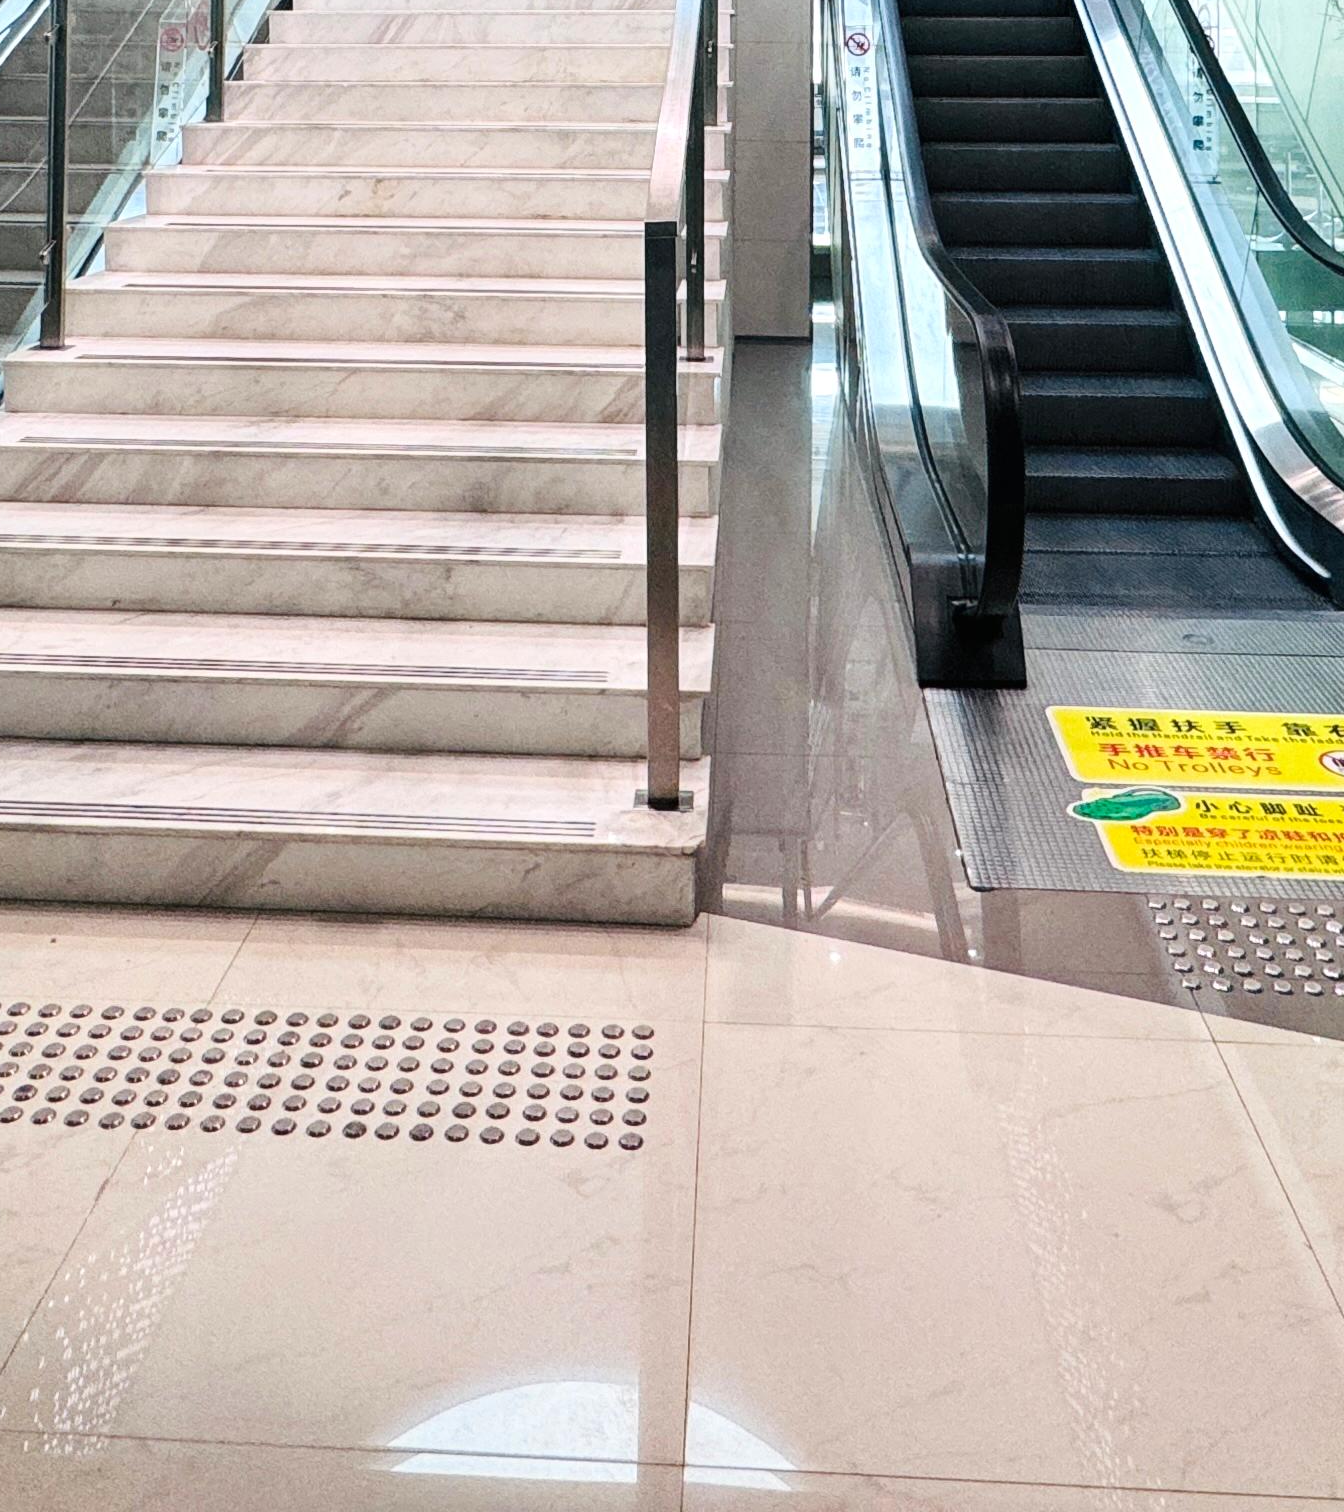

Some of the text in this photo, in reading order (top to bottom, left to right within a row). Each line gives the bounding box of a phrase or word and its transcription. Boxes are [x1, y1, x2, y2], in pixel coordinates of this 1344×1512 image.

[1085, 716, 1246, 734] 紧握扶手
[1246, 735, 1279, 743] Take
[1283, 736, 1309, 744] the
[1099, 743, 1275, 761] 手推车禁行
[1108, 758, 1282, 777] No Trolleys
[1196, 800, 1321, 817] 小心脚趾
[1134, 837, 1211, 848] Especially
[1216, 840, 1277, 850] children
